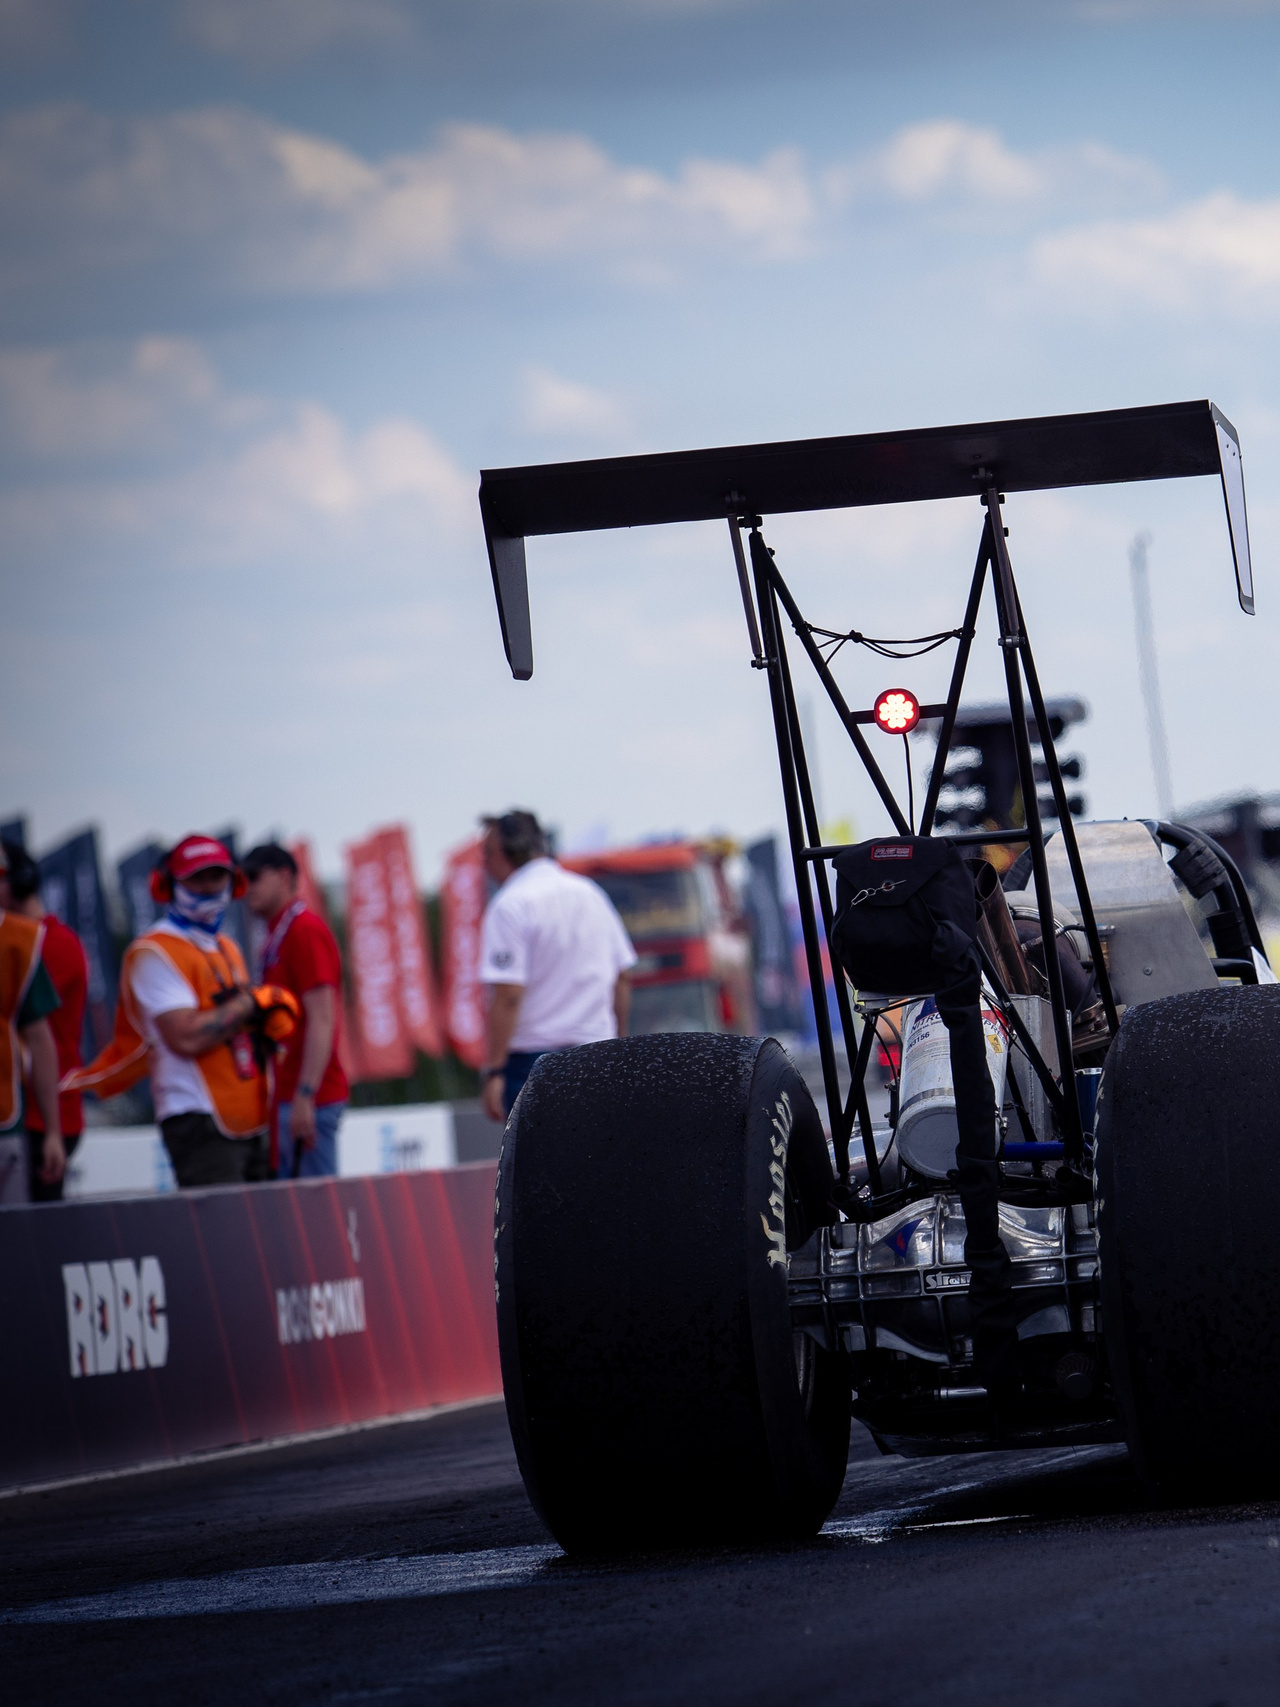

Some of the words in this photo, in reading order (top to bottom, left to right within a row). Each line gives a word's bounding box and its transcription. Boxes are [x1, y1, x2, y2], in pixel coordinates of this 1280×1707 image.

[911, 1011, 942, 1033] NITRO
[925, 1271, 973, 1290] Stran
[62, 1255, 169, 1379] RDRC
